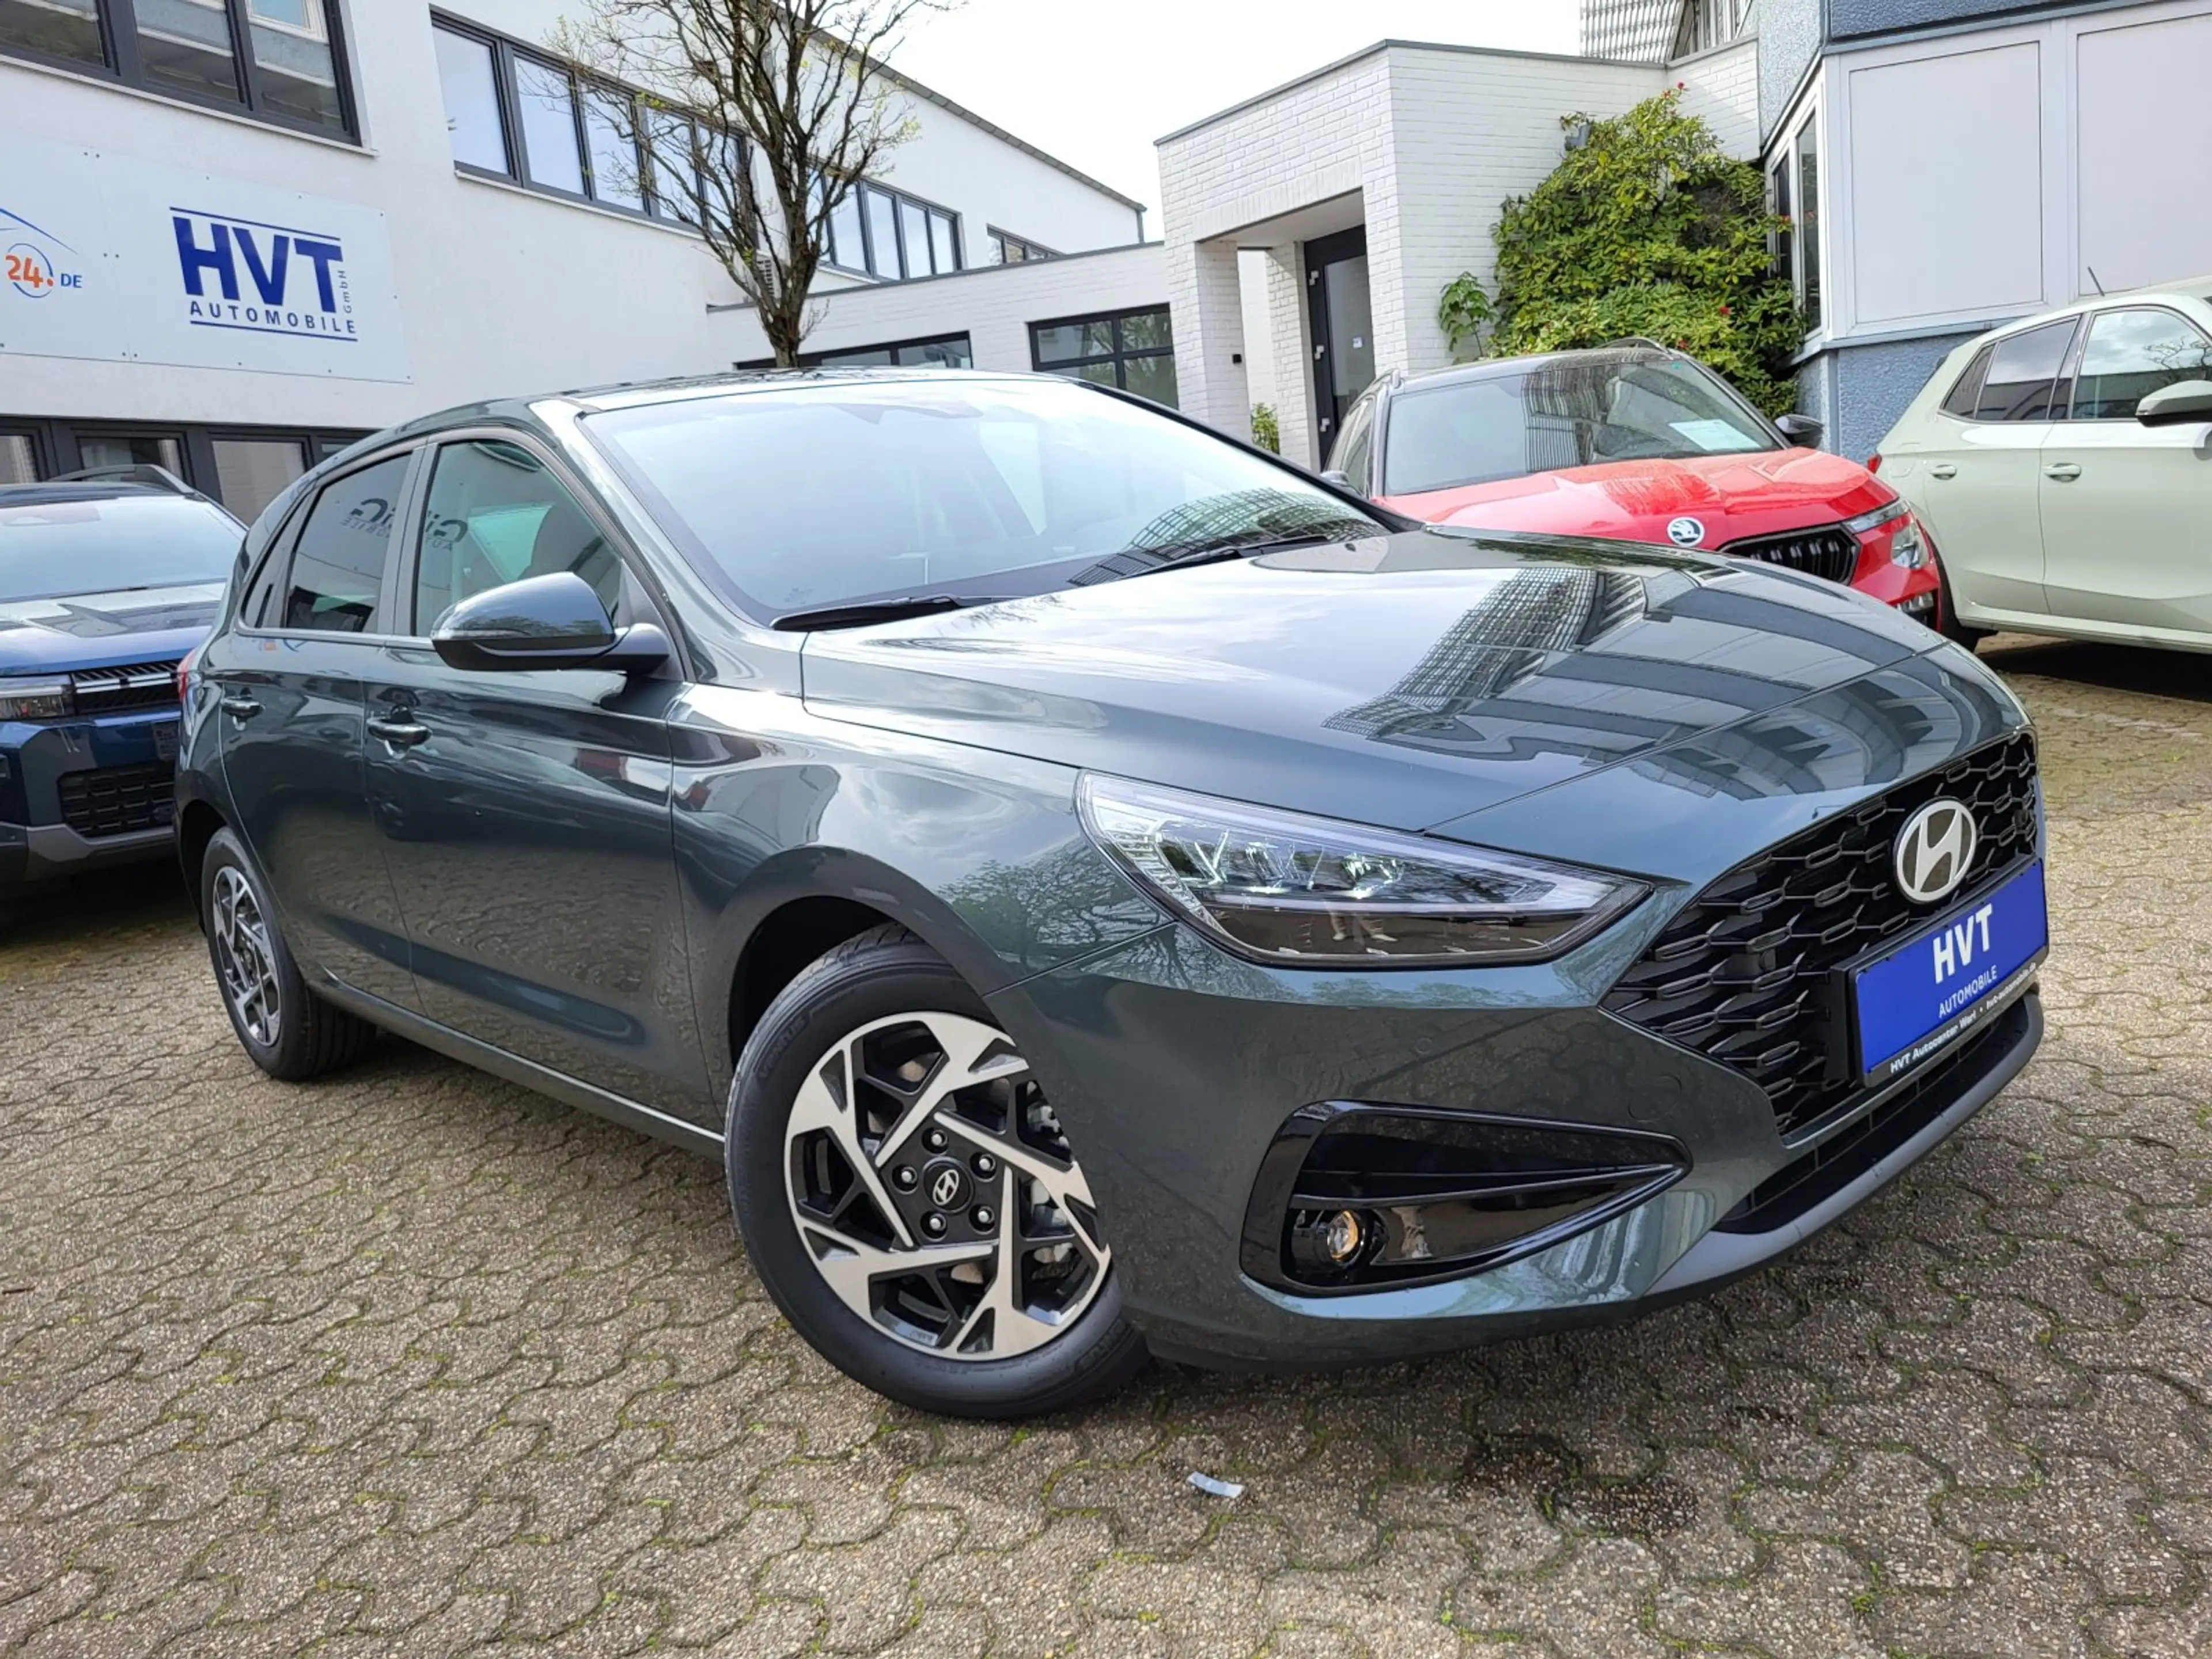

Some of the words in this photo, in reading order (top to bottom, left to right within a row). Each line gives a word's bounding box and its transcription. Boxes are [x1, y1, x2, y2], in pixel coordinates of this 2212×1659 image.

[172, 215, 344, 314] HVT
[337, 269, 352, 314] GmbH
[190, 300, 357, 334] AUTOMOBILE
[1933, 903, 1993, 984] HVT
[1938, 964, 1997, 1019] AUTOMOBILE
[1890, 1052, 1911, 1074] HVT
